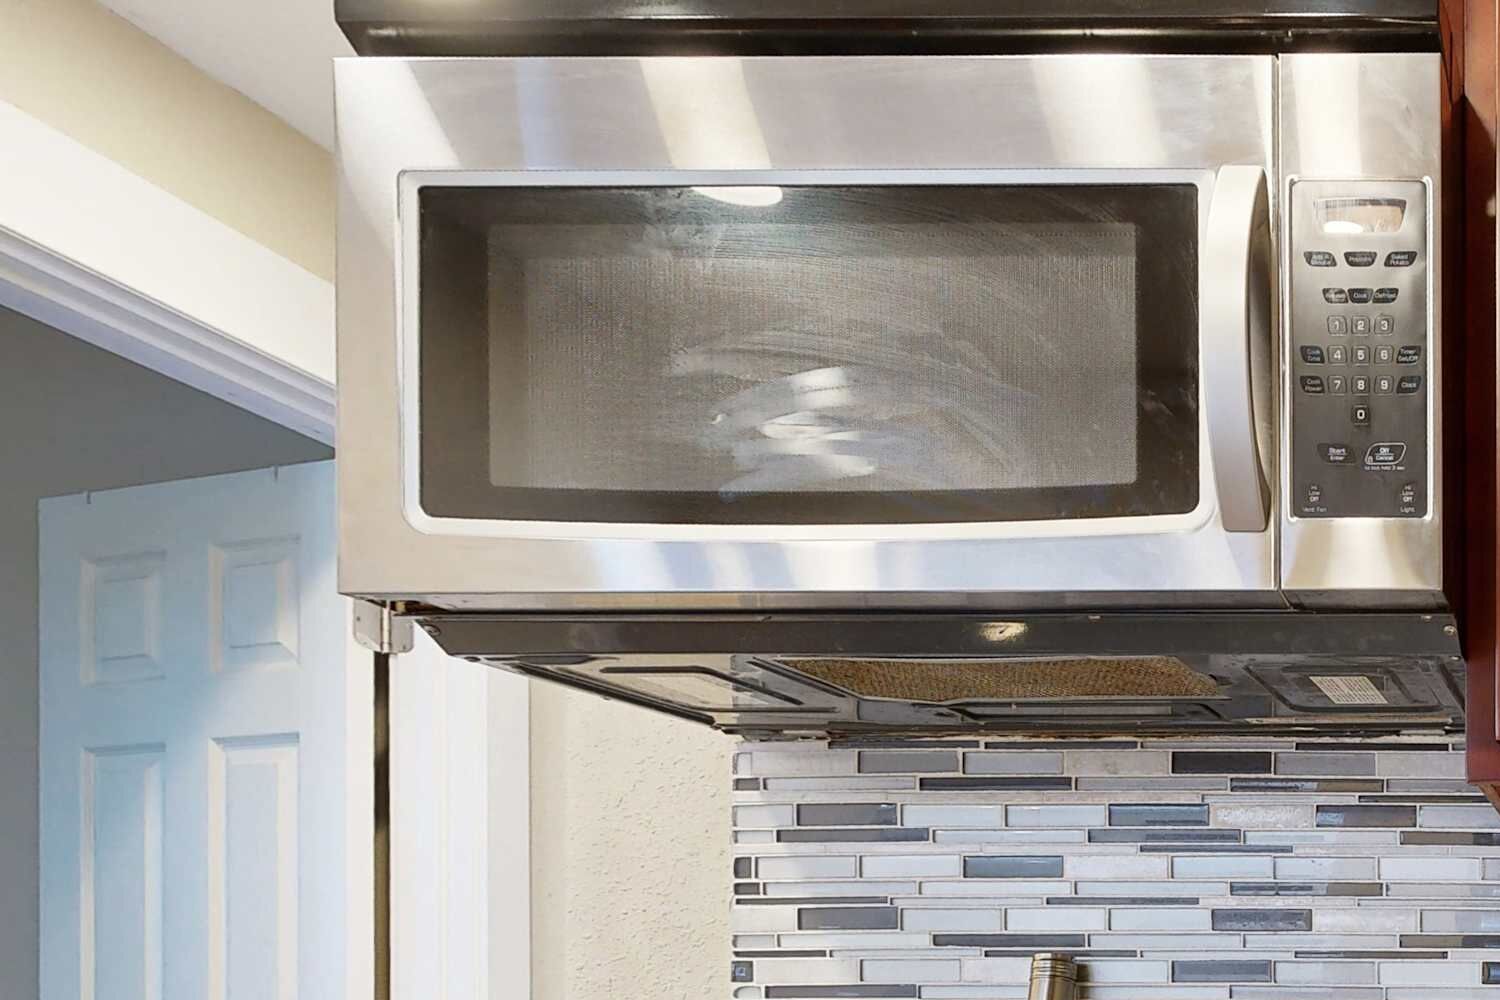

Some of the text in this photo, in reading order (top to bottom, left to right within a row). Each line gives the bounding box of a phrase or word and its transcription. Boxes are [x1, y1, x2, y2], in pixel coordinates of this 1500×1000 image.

[1334, 320, 1340, 330] 1
[1357, 320, 1365, 330] 2
[1380, 320, 1388, 330] 3
[1334, 350, 1342, 360] 4
[1357, 350, 1365, 360] 5
[1380, 350, 1388, 360] 6
[1334, 380, 1341, 390] 7
[1357, 380, 1365, 390] 8
[1380, 380, 1388, 390] 9
[1357, 409, 1365, 420] 0
